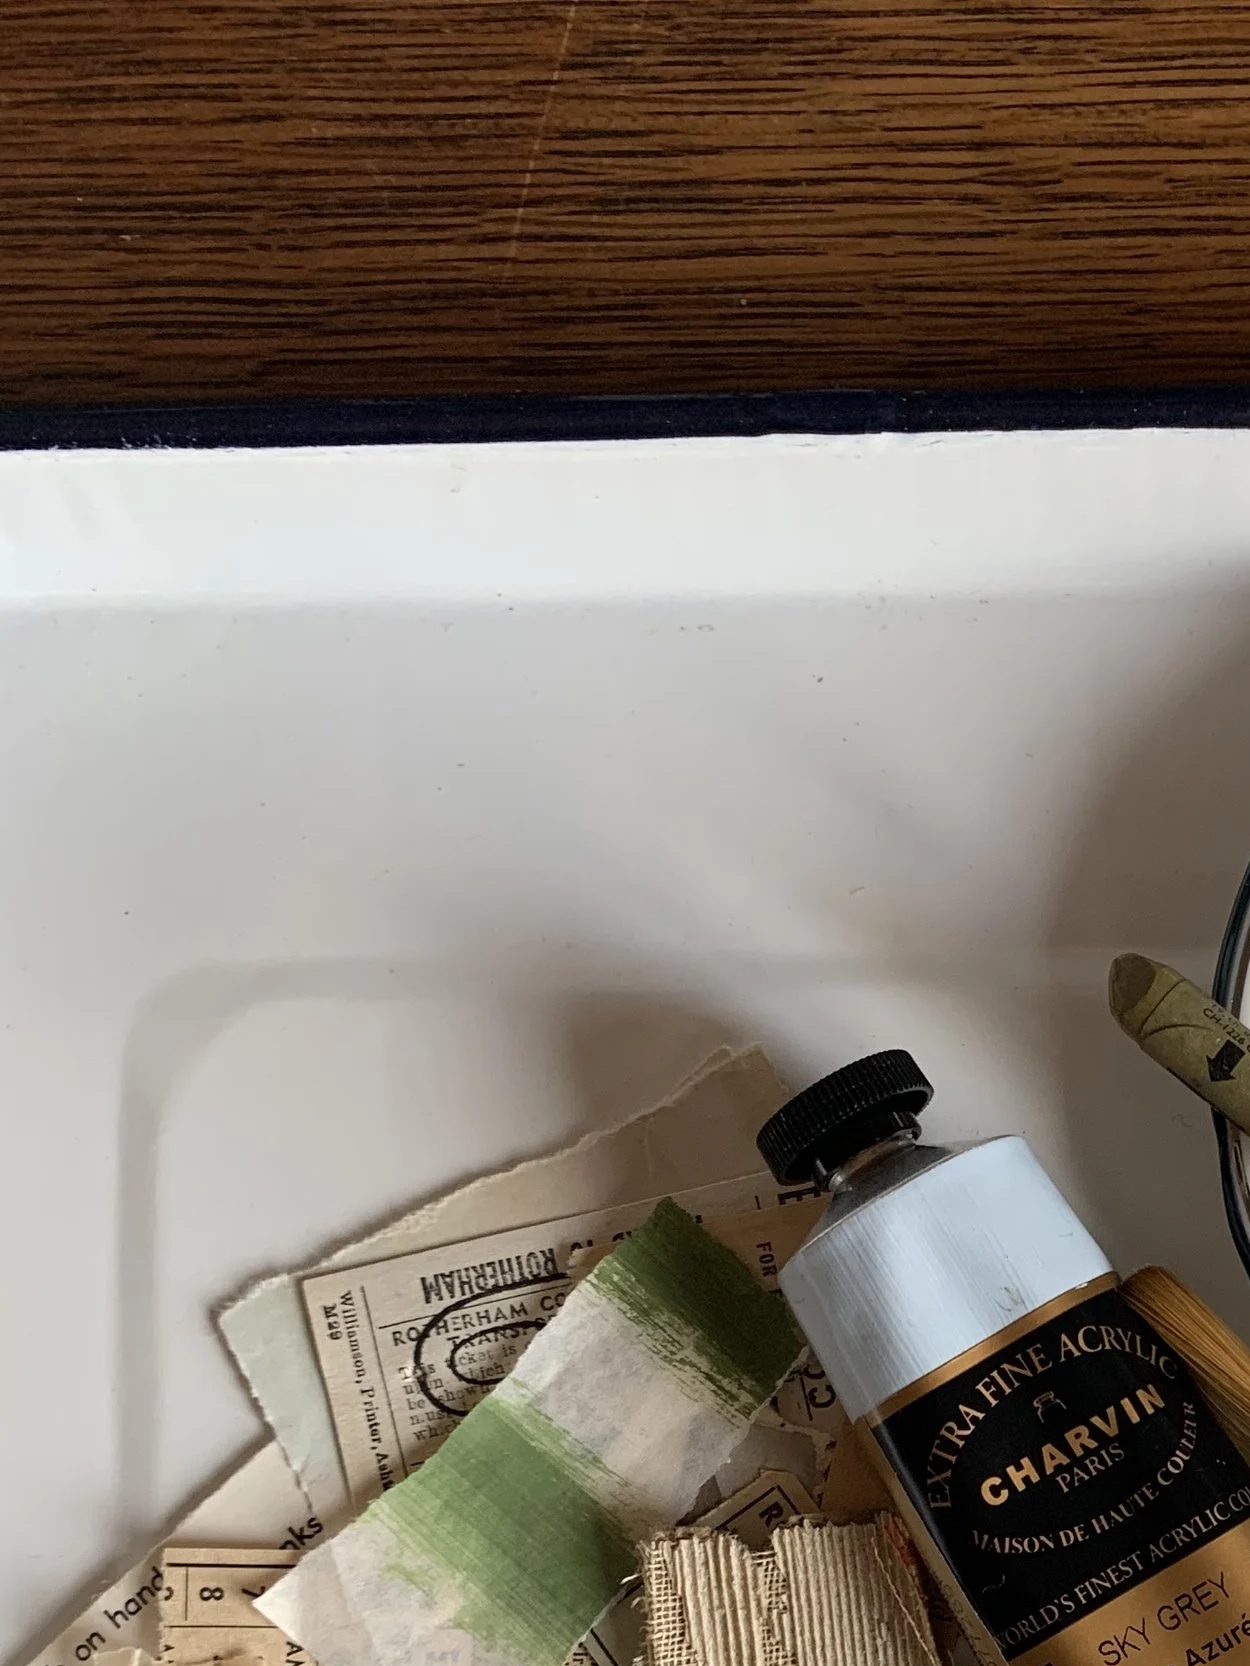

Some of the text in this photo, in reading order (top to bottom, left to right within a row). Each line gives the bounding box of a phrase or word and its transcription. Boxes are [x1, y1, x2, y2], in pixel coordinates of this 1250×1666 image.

[756, 1241, 778, 1277] FOR
[323, 1304, 344, 1341] M29
[926, 1324, 1178, 1509] EXTRA FINE ACRYLIC
[980, 1383, 1166, 1507] CHARVIN
[1055, 1442, 1126, 1494] PARIS
[970, 1529, 1055, 1554] MAISON
[1059, 1522, 1090, 1548] DE
[1090, 1482, 1160, 1535] HAUTE
[1074, 1550, 1145, 1606] FINEST
[1150, 1501, 1231, 1563] ACRYLIC
[1157, 1571, 1231, 1631] GREY
[74, 1630, 107, 1662] on
